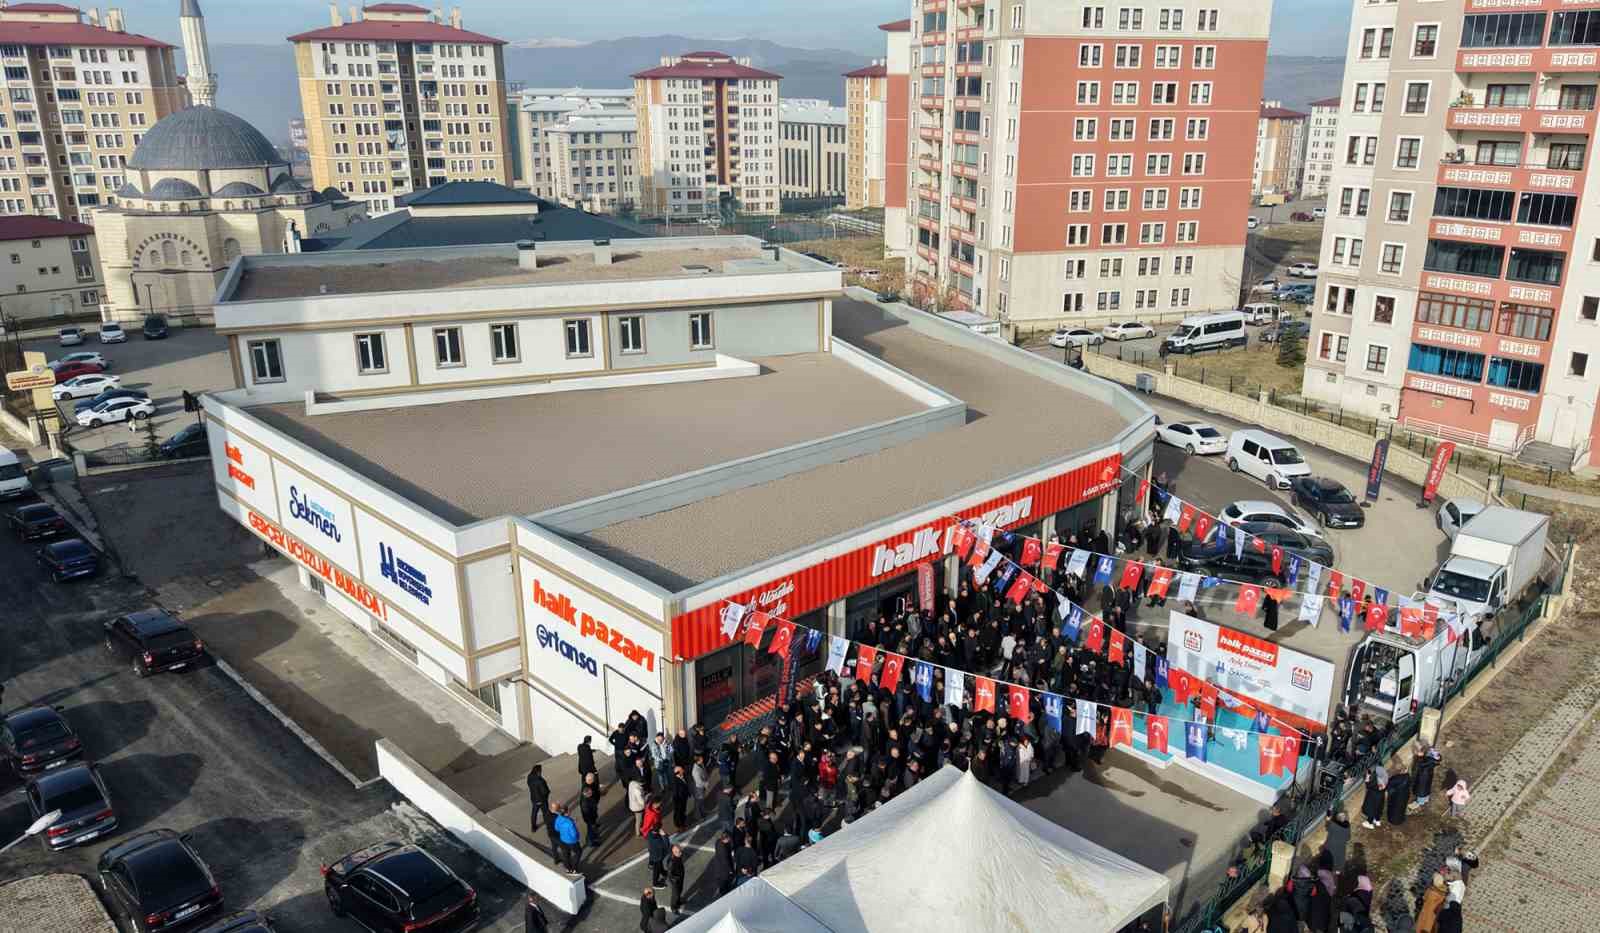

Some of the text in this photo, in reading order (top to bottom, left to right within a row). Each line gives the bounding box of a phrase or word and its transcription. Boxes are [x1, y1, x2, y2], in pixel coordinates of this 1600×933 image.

[289, 485, 342, 543] Sekmen
[872, 526, 942, 577] halk
[248, 510, 286, 549] GERÇEK
[286, 535, 333, 582] UCUZLUK
[334, 569, 382, 618] BURADA
[533, 578, 655, 673] halk pazarı
